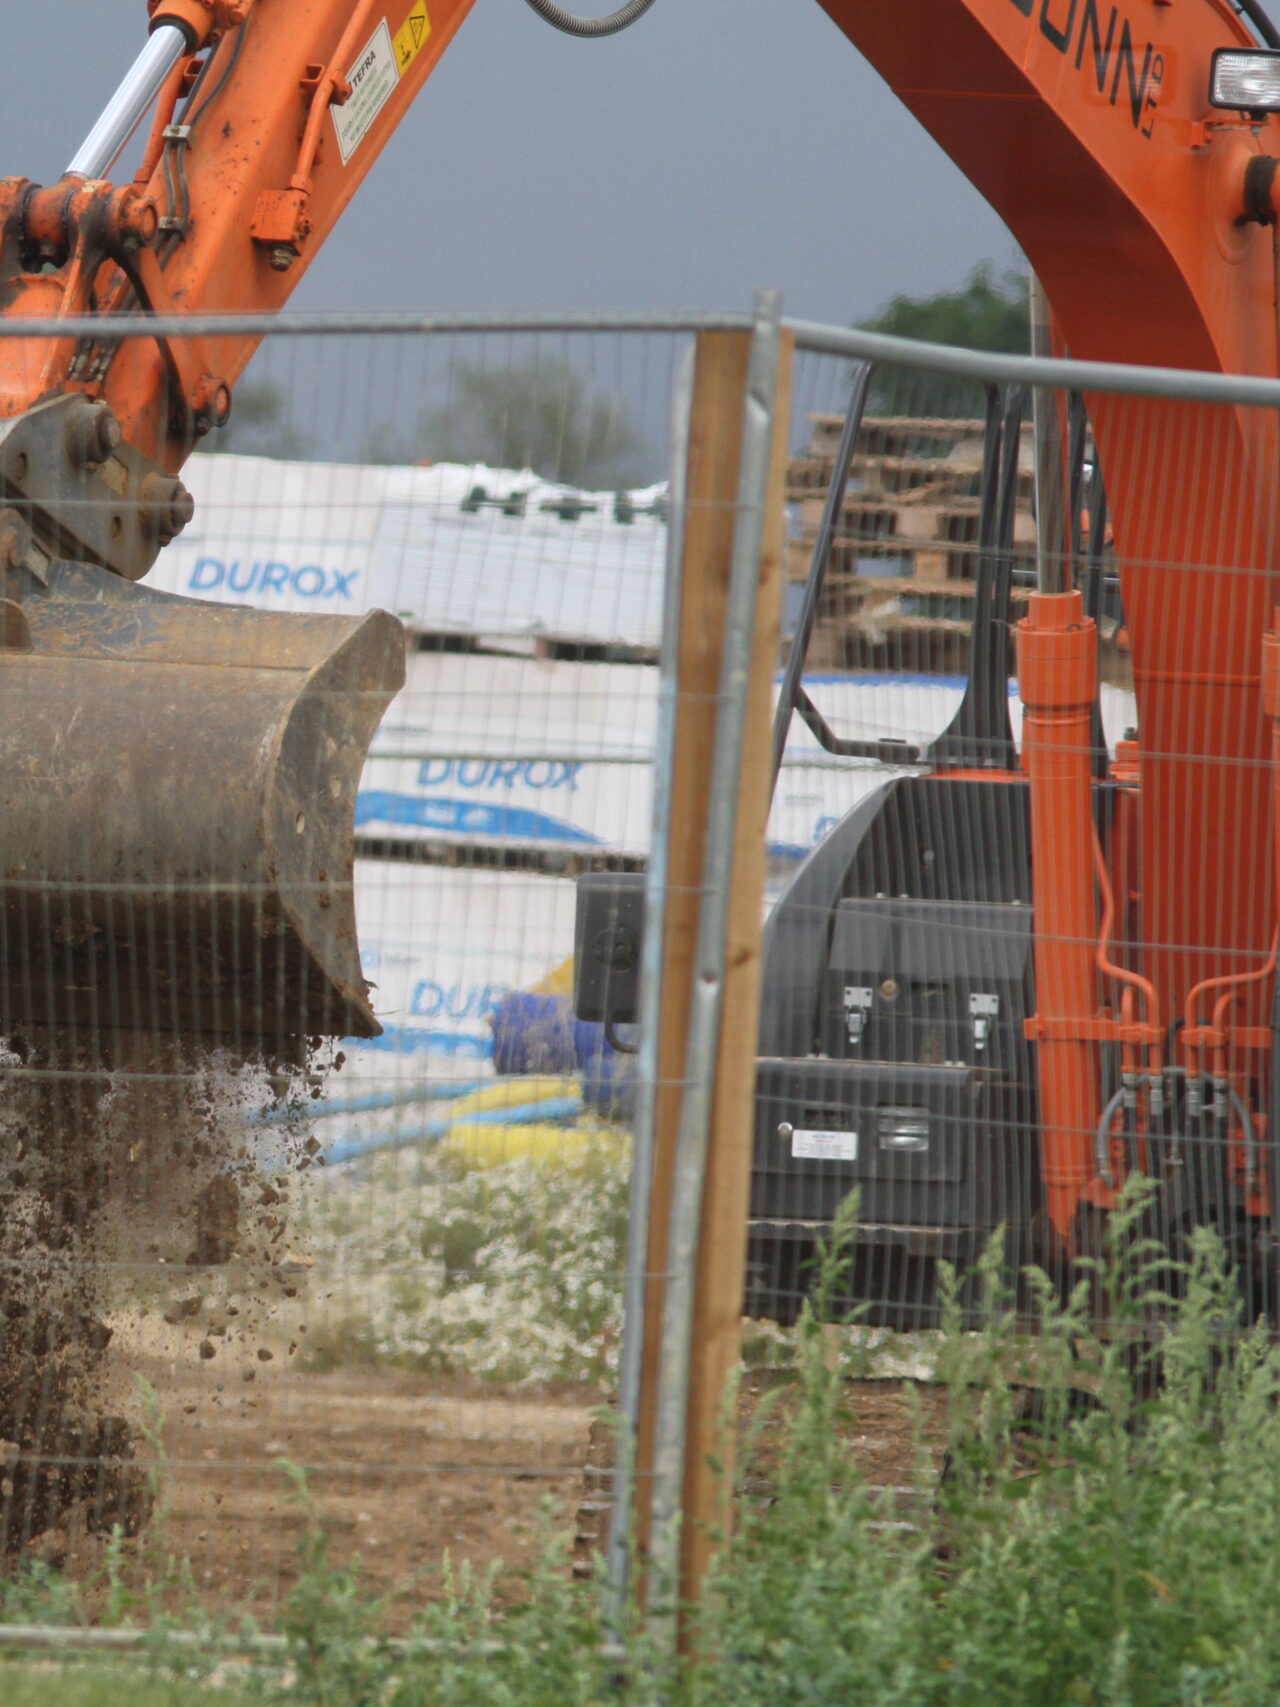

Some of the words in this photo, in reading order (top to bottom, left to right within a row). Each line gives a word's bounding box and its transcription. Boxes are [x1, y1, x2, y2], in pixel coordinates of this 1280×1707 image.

[1008, 0, 1153, 129] UNN
[187, 556, 360, 600] DUROX
[417, 760, 583, 792] DUROX
